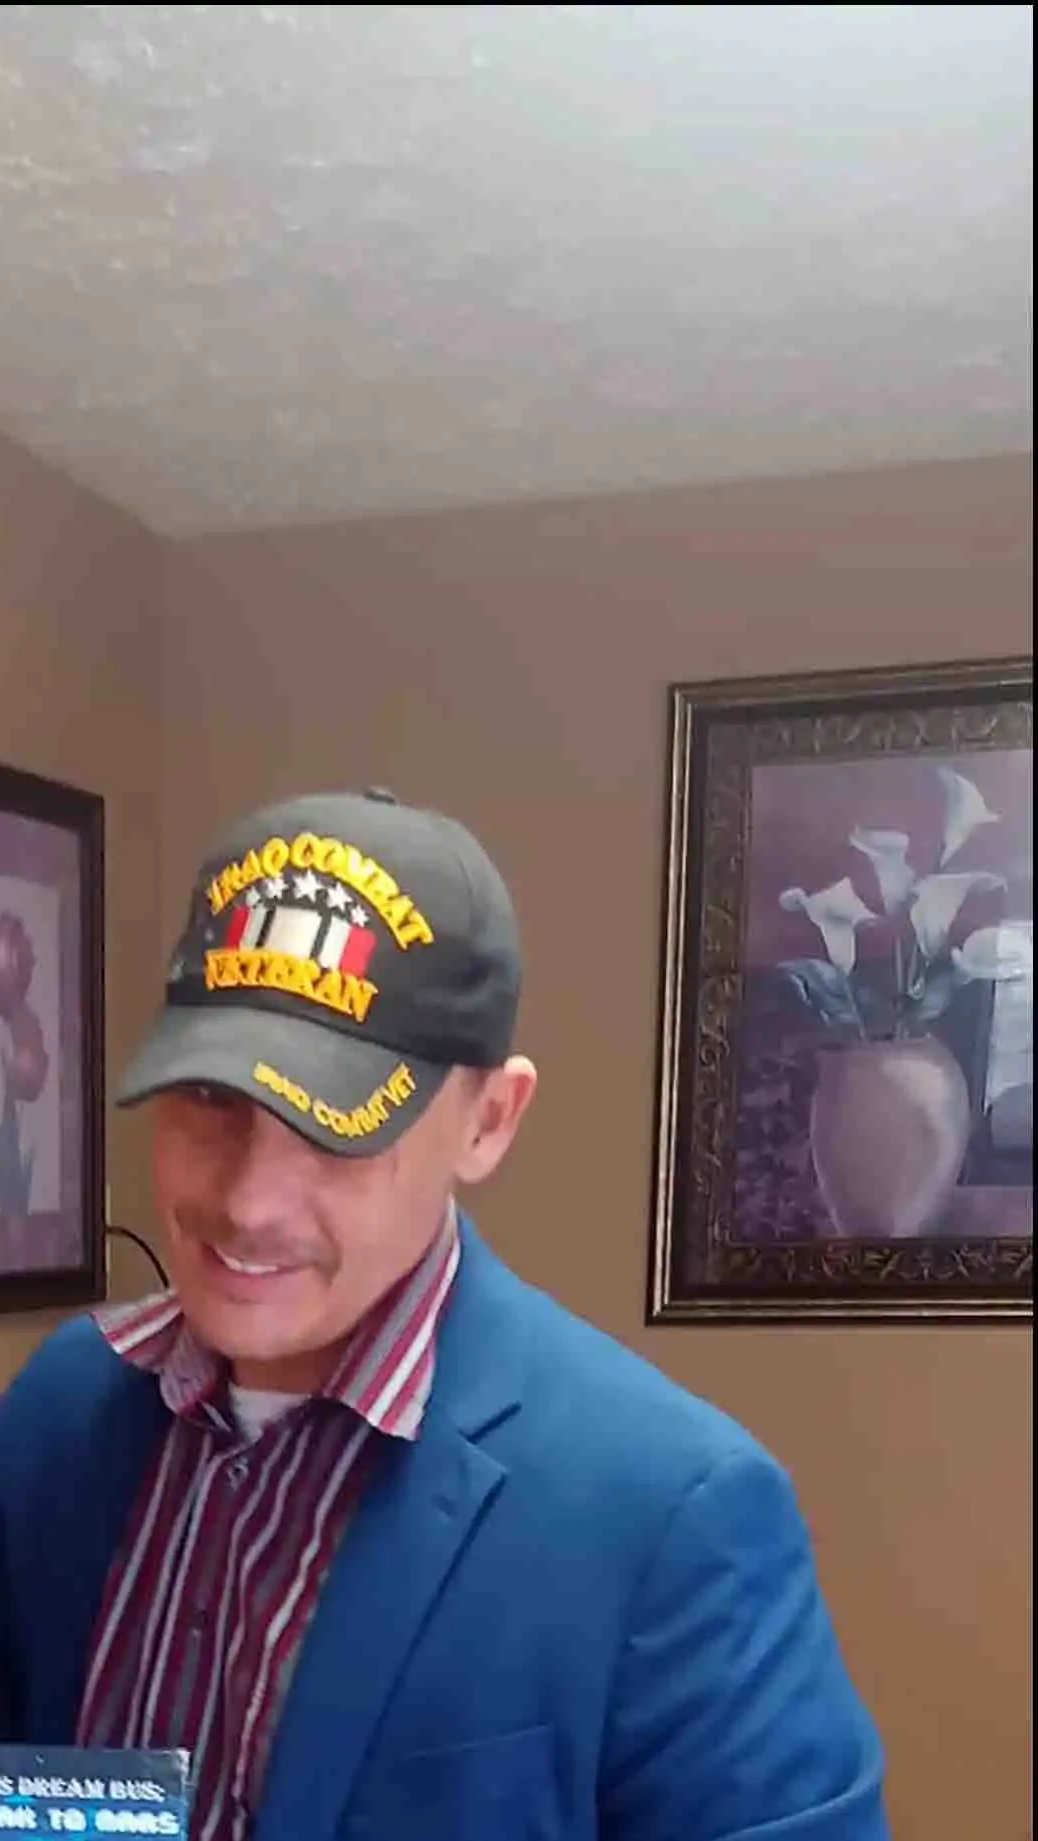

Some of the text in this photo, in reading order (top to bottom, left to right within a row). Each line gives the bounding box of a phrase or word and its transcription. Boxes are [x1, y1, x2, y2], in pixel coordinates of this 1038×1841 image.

[289, 832, 434, 950] COMBAT
[204, 949, 378, 1022] VETERAN
[380, 1061, 417, 1106] VET
[17, 1775, 105, 1800] DREAM
[46, 1808, 86, 1831] TO
[94, 1809, 180, 1835] MARS
